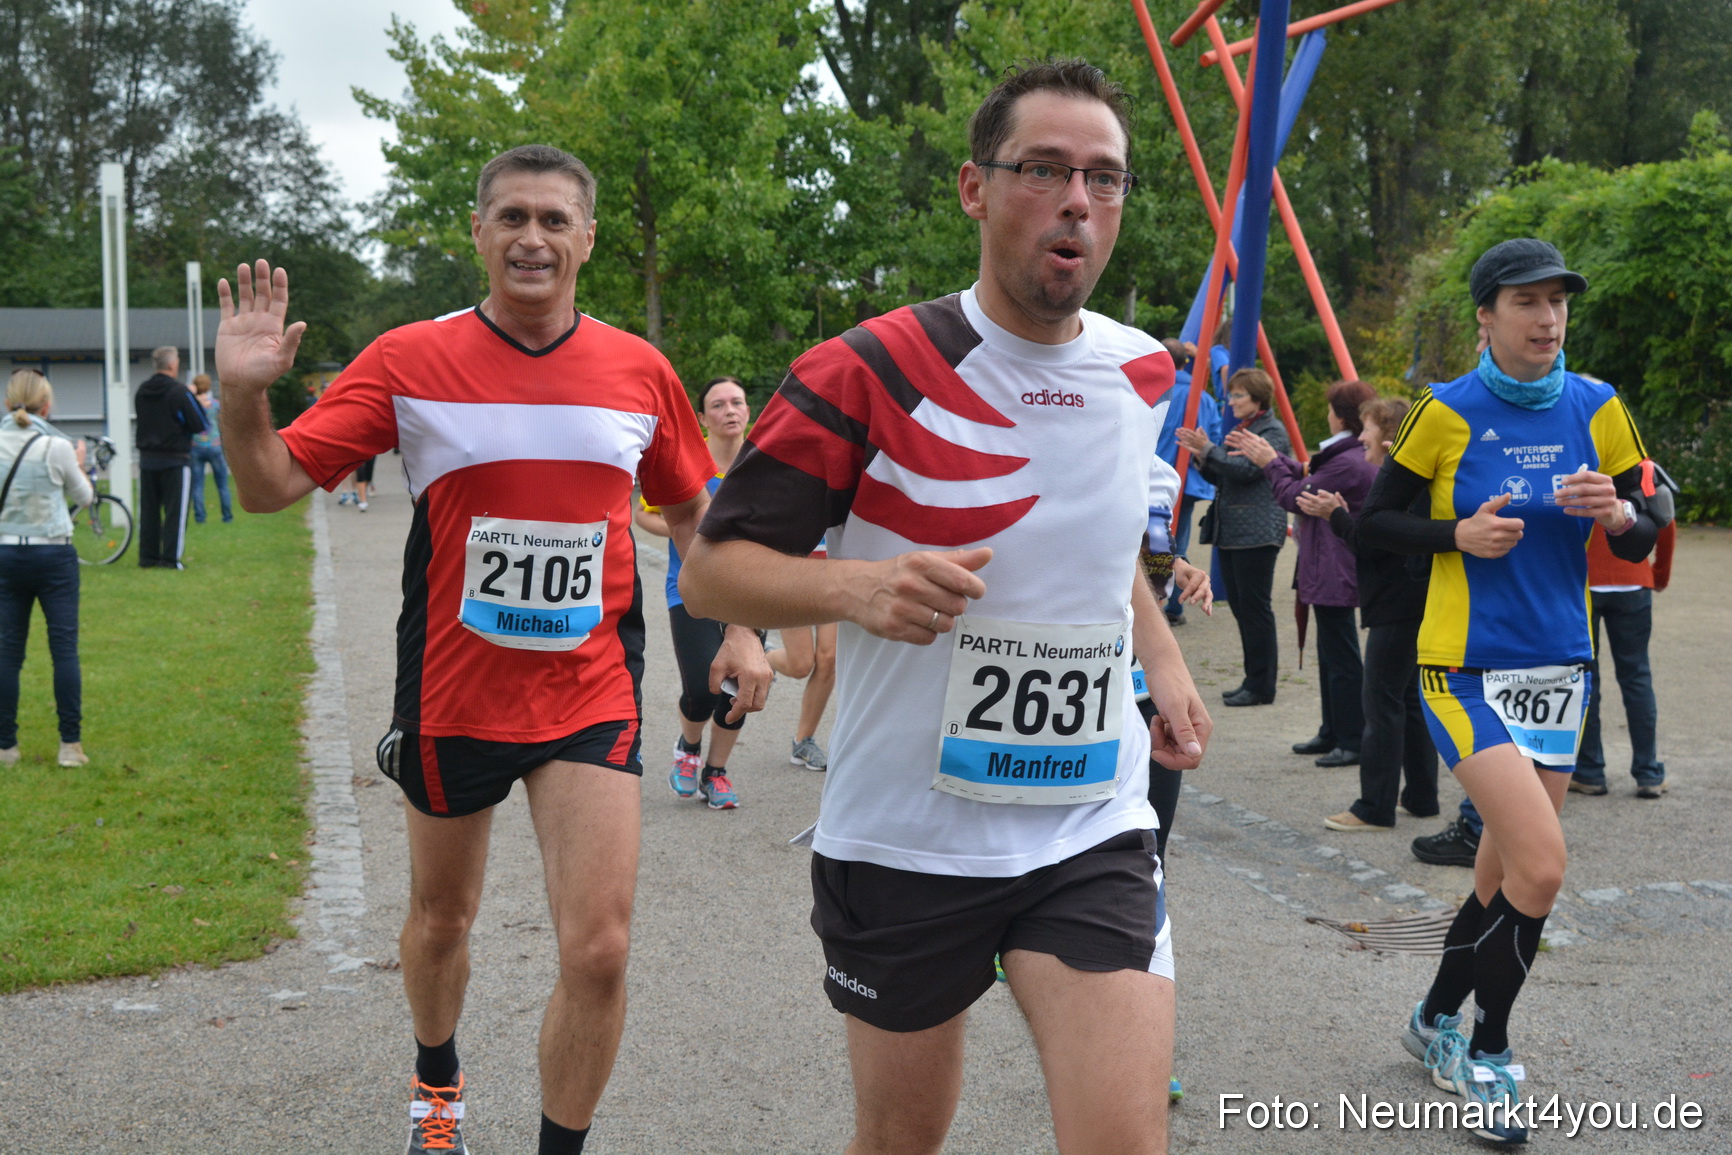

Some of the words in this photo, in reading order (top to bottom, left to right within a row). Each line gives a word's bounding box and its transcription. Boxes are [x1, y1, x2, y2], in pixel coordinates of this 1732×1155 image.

[1021, 389, 1084, 408] adidas
[1513, 445, 1564, 455] INTERSPORT
[1516, 454, 1556, 464] LANGE
[471, 530, 519, 546] PARTL
[524, 535, 588, 549] Neumarkt
[479, 551, 592, 603] 2105
[496, 611, 570, 633] Michael
[959, 634, 1028, 657] PARTL
[1033, 642, 1112, 660] Neumarkt
[1486, 674, 1523, 684] PARTL
[1526, 675, 1567, 685] Neumarkt
[965, 665, 1112, 736] 2631
[1495, 689, 1573, 725] 2867
[950, 723, 958, 735] D
[986, 752, 1087, 779] Manfred
[828, 965, 878, 999] adidas
